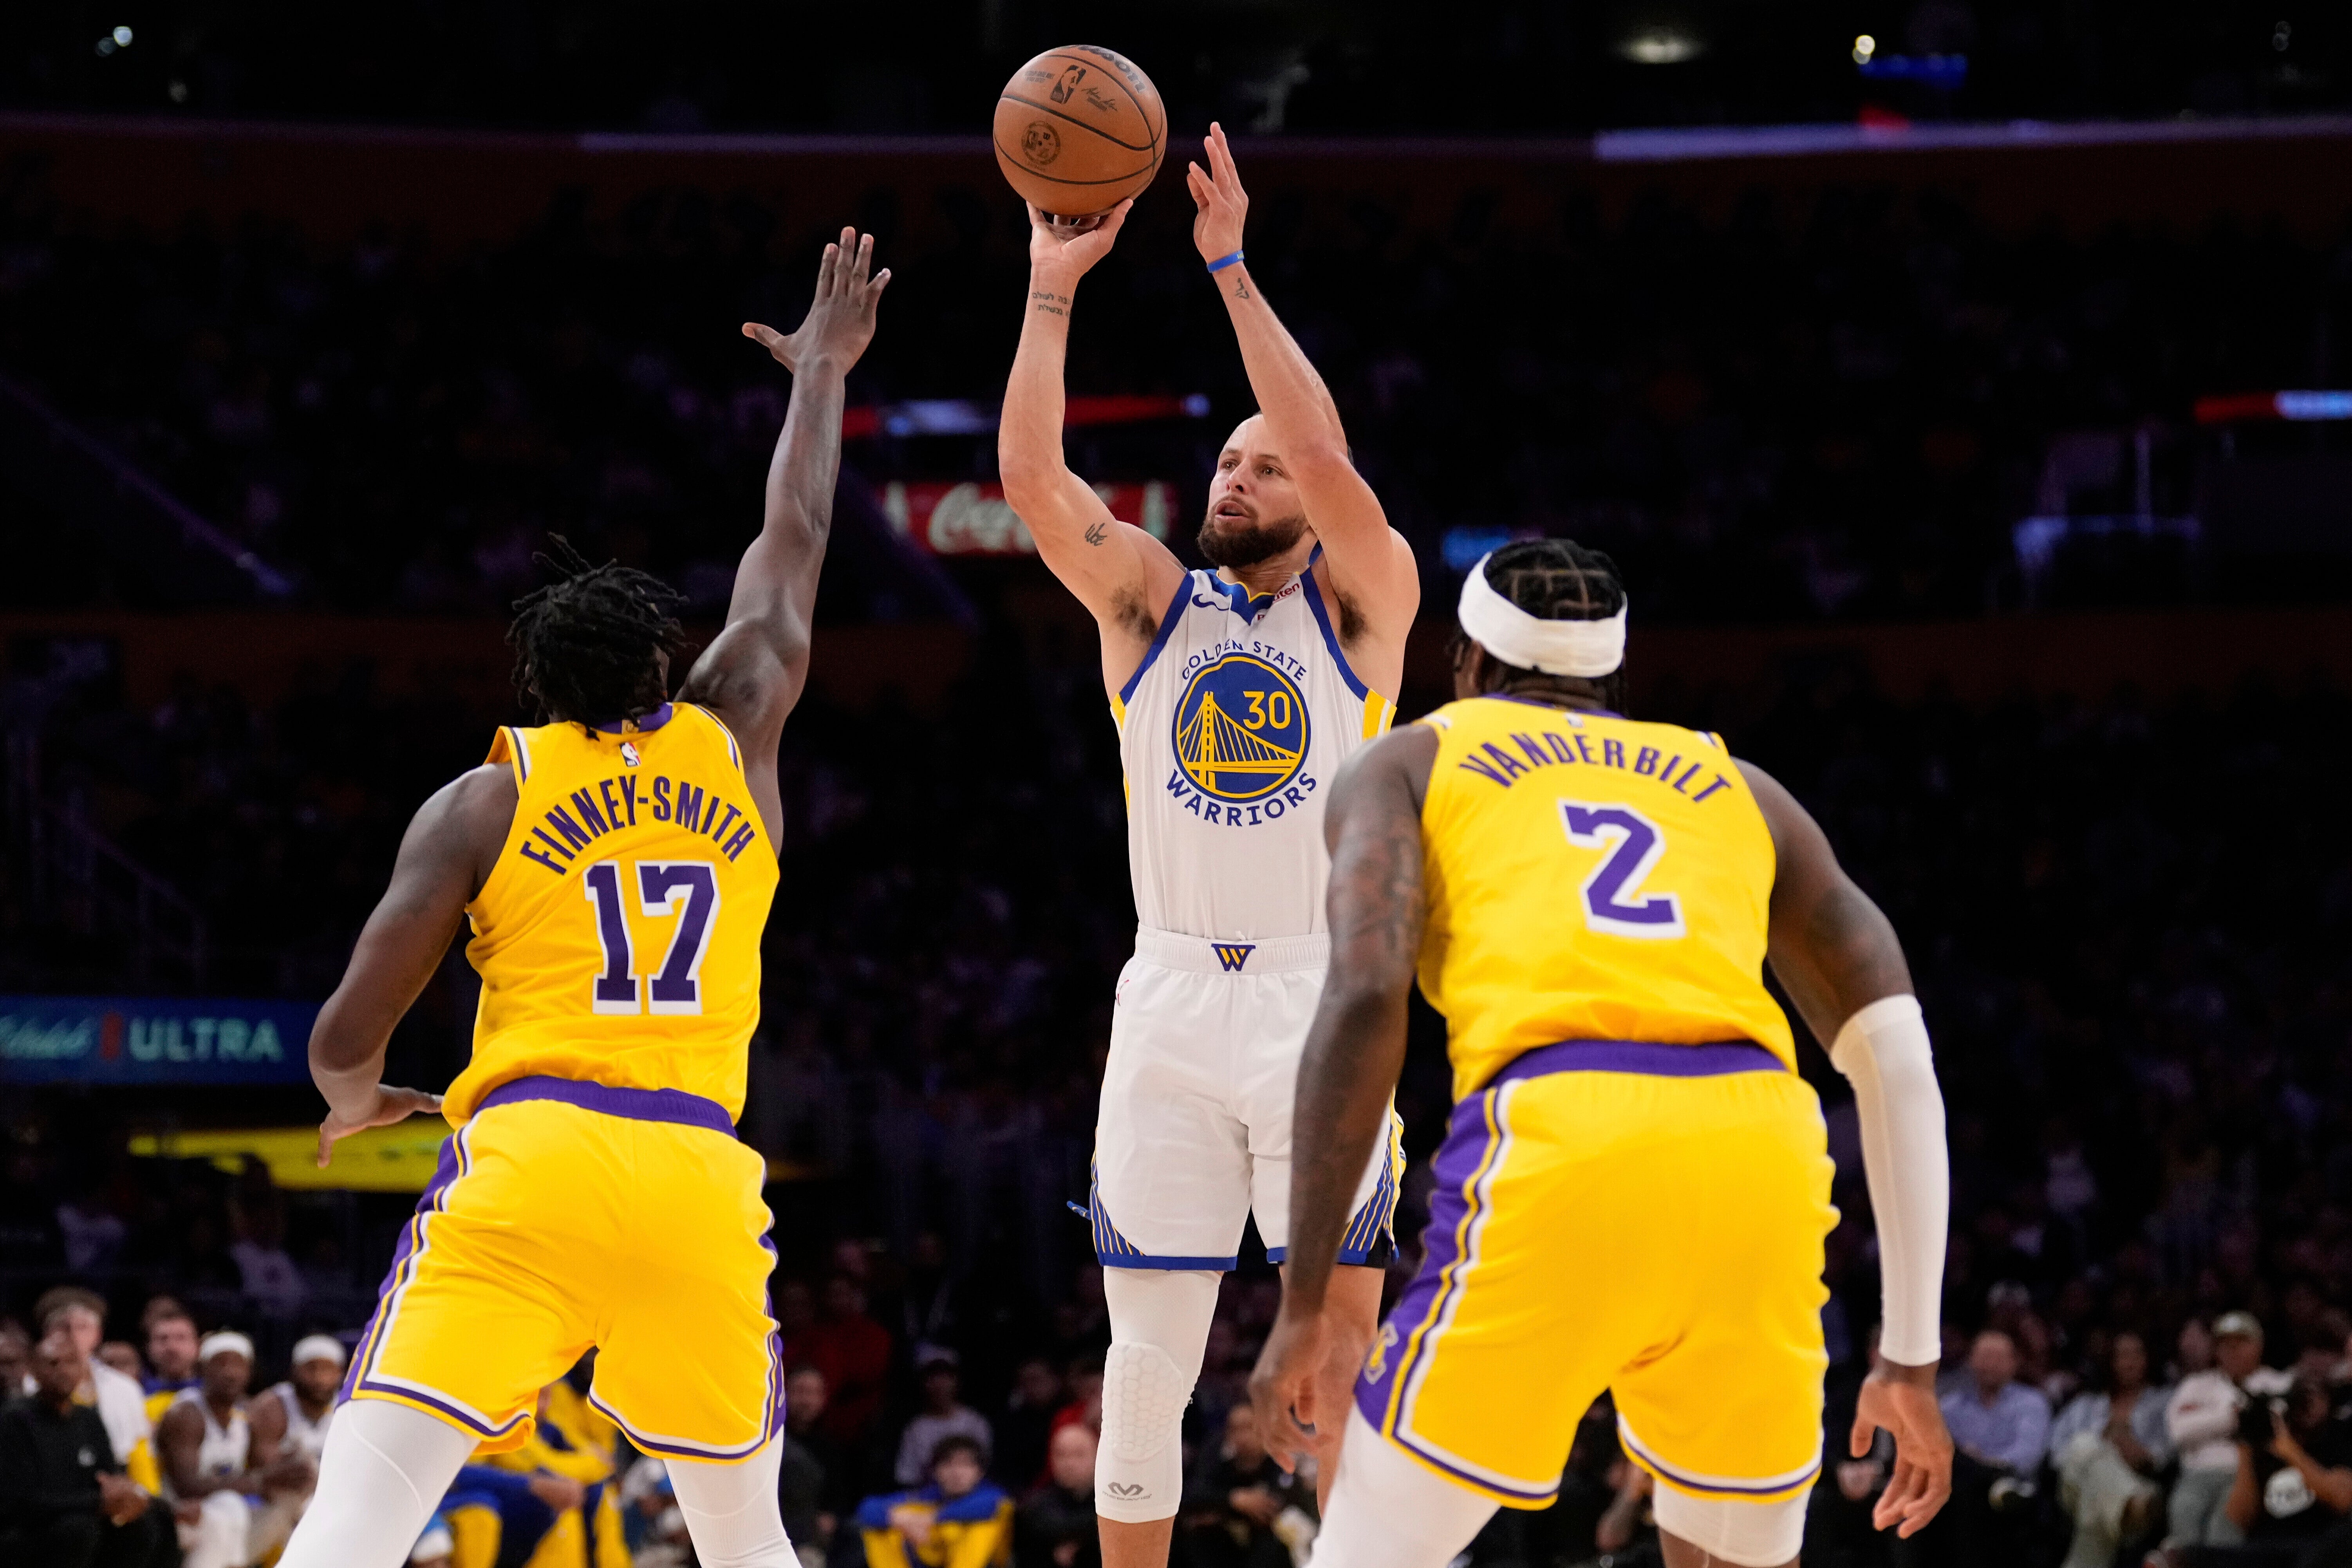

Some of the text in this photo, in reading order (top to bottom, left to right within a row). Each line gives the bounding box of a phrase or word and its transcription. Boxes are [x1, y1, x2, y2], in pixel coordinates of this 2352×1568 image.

[1182, 638, 1307, 682] GOLDEN STATE
[1243, 691, 1291, 730] 30
[1166, 769, 1317, 826] WARRIORS
[1459, 732, 1732, 804] VANDERBILT
[520, 774, 757, 876] FINNEY-SMITH
[1558, 798, 1686, 939] 2
[582, 859, 722, 1017] 17
[128, 1016, 284, 1063] ULTRA
